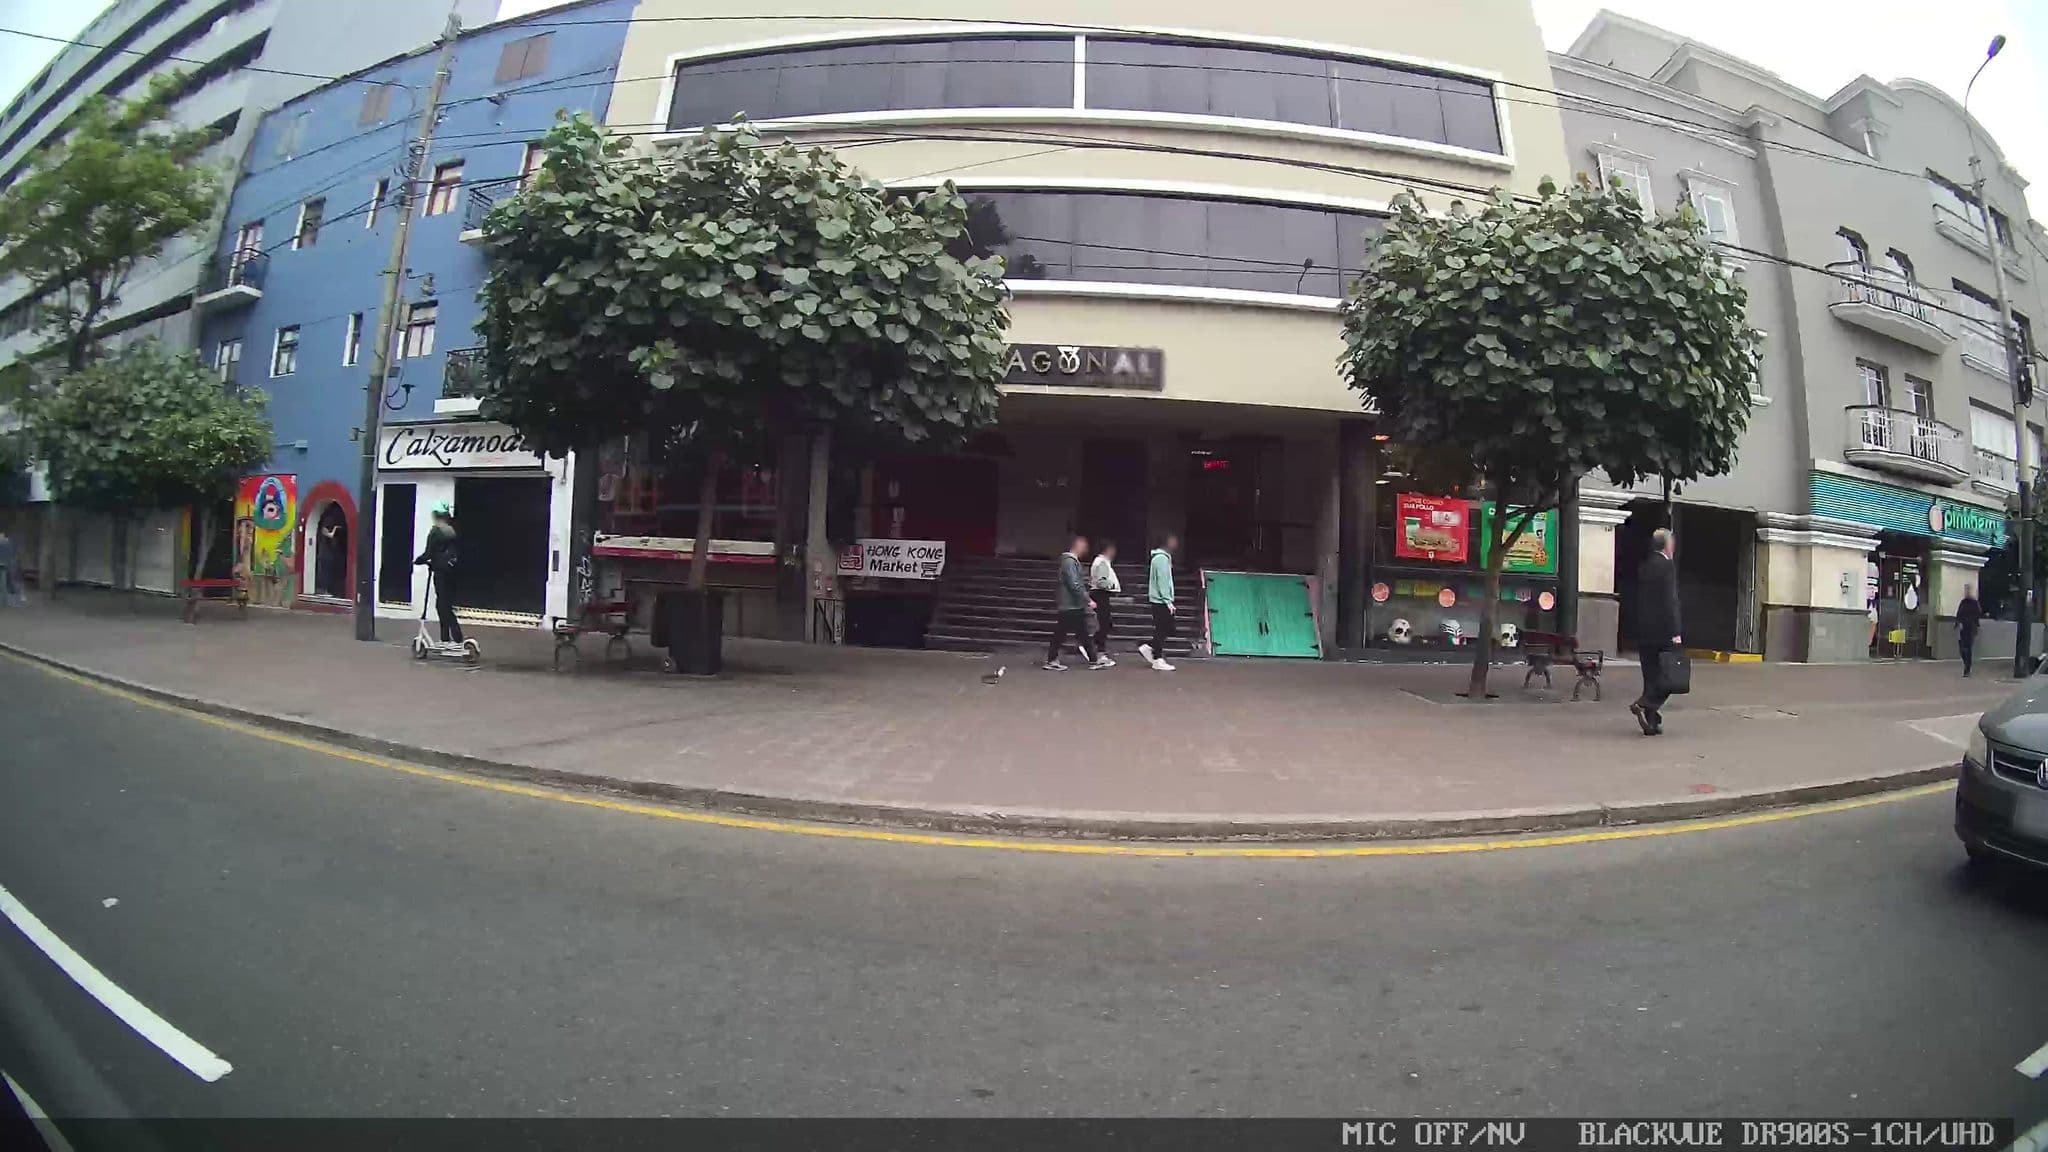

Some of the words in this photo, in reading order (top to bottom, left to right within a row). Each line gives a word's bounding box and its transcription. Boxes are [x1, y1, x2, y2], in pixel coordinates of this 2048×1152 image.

[867, 545, 901, 558] HONG
[907, 546, 944, 560] KONG
[869, 559, 918, 573] Market
